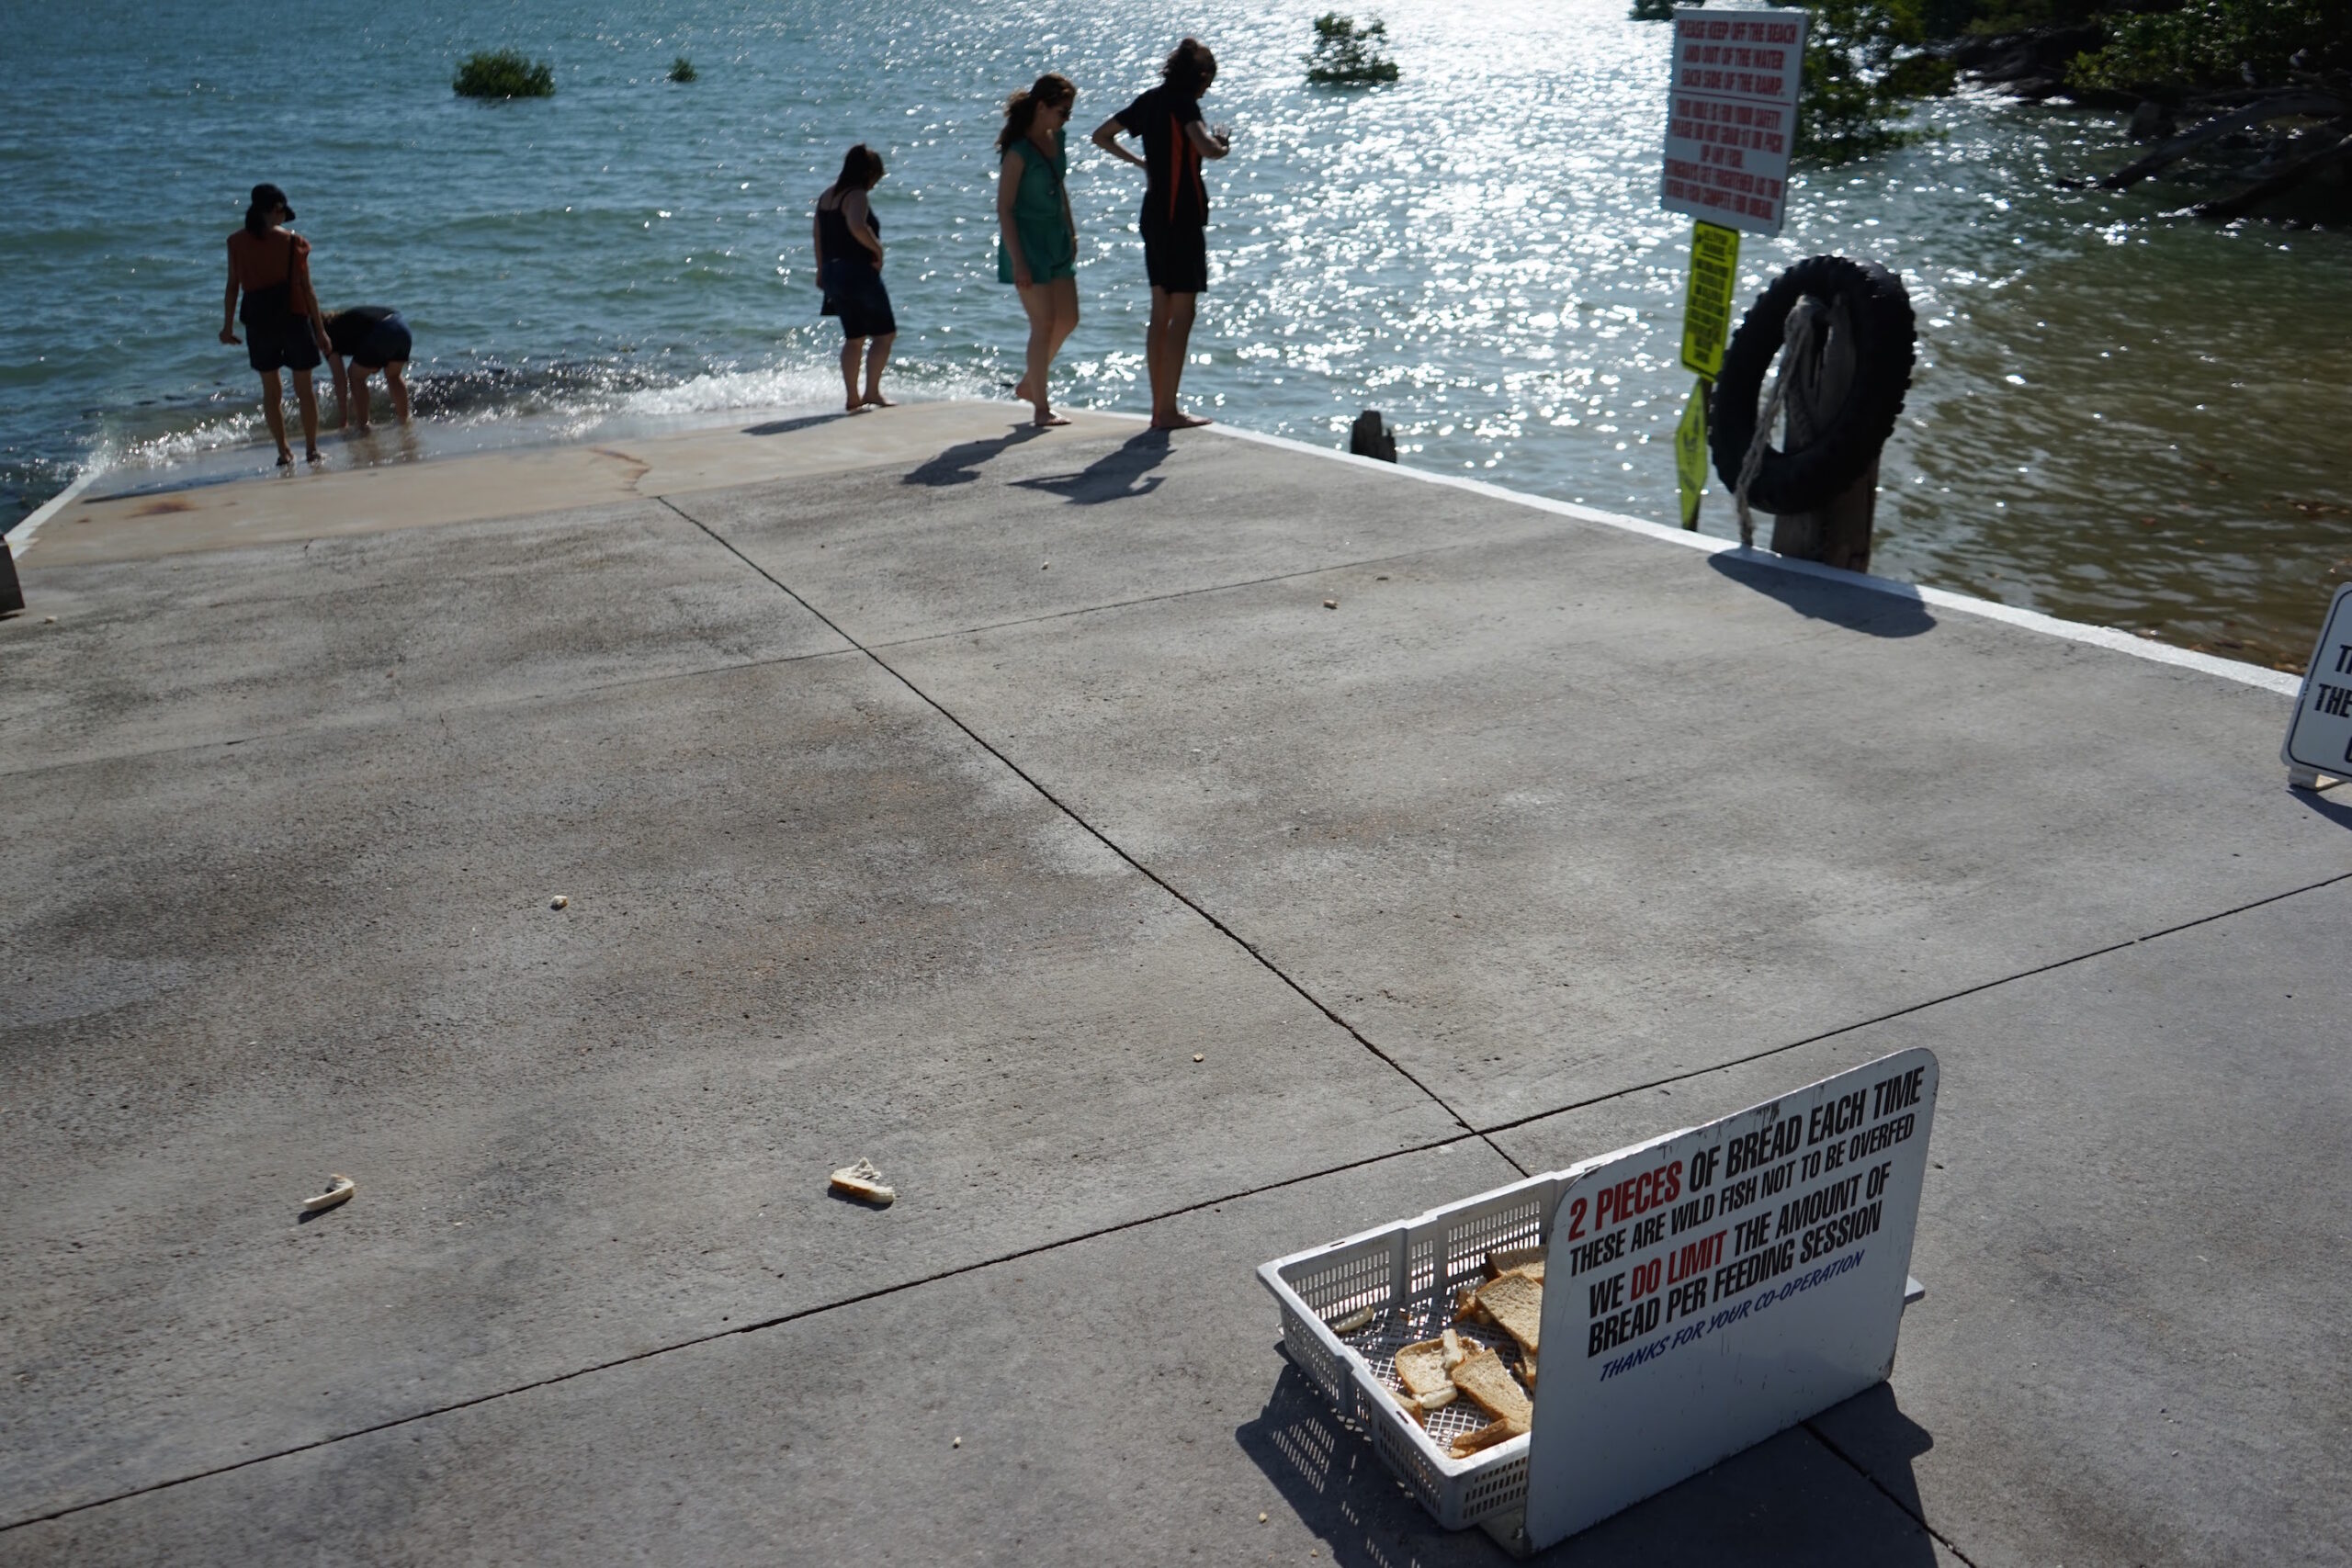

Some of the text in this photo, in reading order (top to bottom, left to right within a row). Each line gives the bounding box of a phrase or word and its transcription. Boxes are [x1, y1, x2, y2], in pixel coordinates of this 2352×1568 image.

[1679, 20, 1797, 44] PLEASE KEEP OFF THE BEACH
[1683, 45, 1784, 70] AND OUT OF THE WATER
[1703, 70, 1723, 88] SIDE
[1725, 72, 1736, 89] OF
[1737, 73, 1753, 92] THE
[1568, 1066, 1925, 1241] 2 PIECES OF BREAD EACH TIME
[1570, 1112, 1915, 1277] THESE ARE WILD FISH NOT TO BE OVERFED
[1588, 1201, 1883, 1358] BREAD PER FEEDING SESSION
[1589, 1161, 1892, 1318] WE DO LIMIT THE AMOUNT OF
[1601, 1249, 1864, 1382] THANKS FOR YOUR CO-OPERATION
